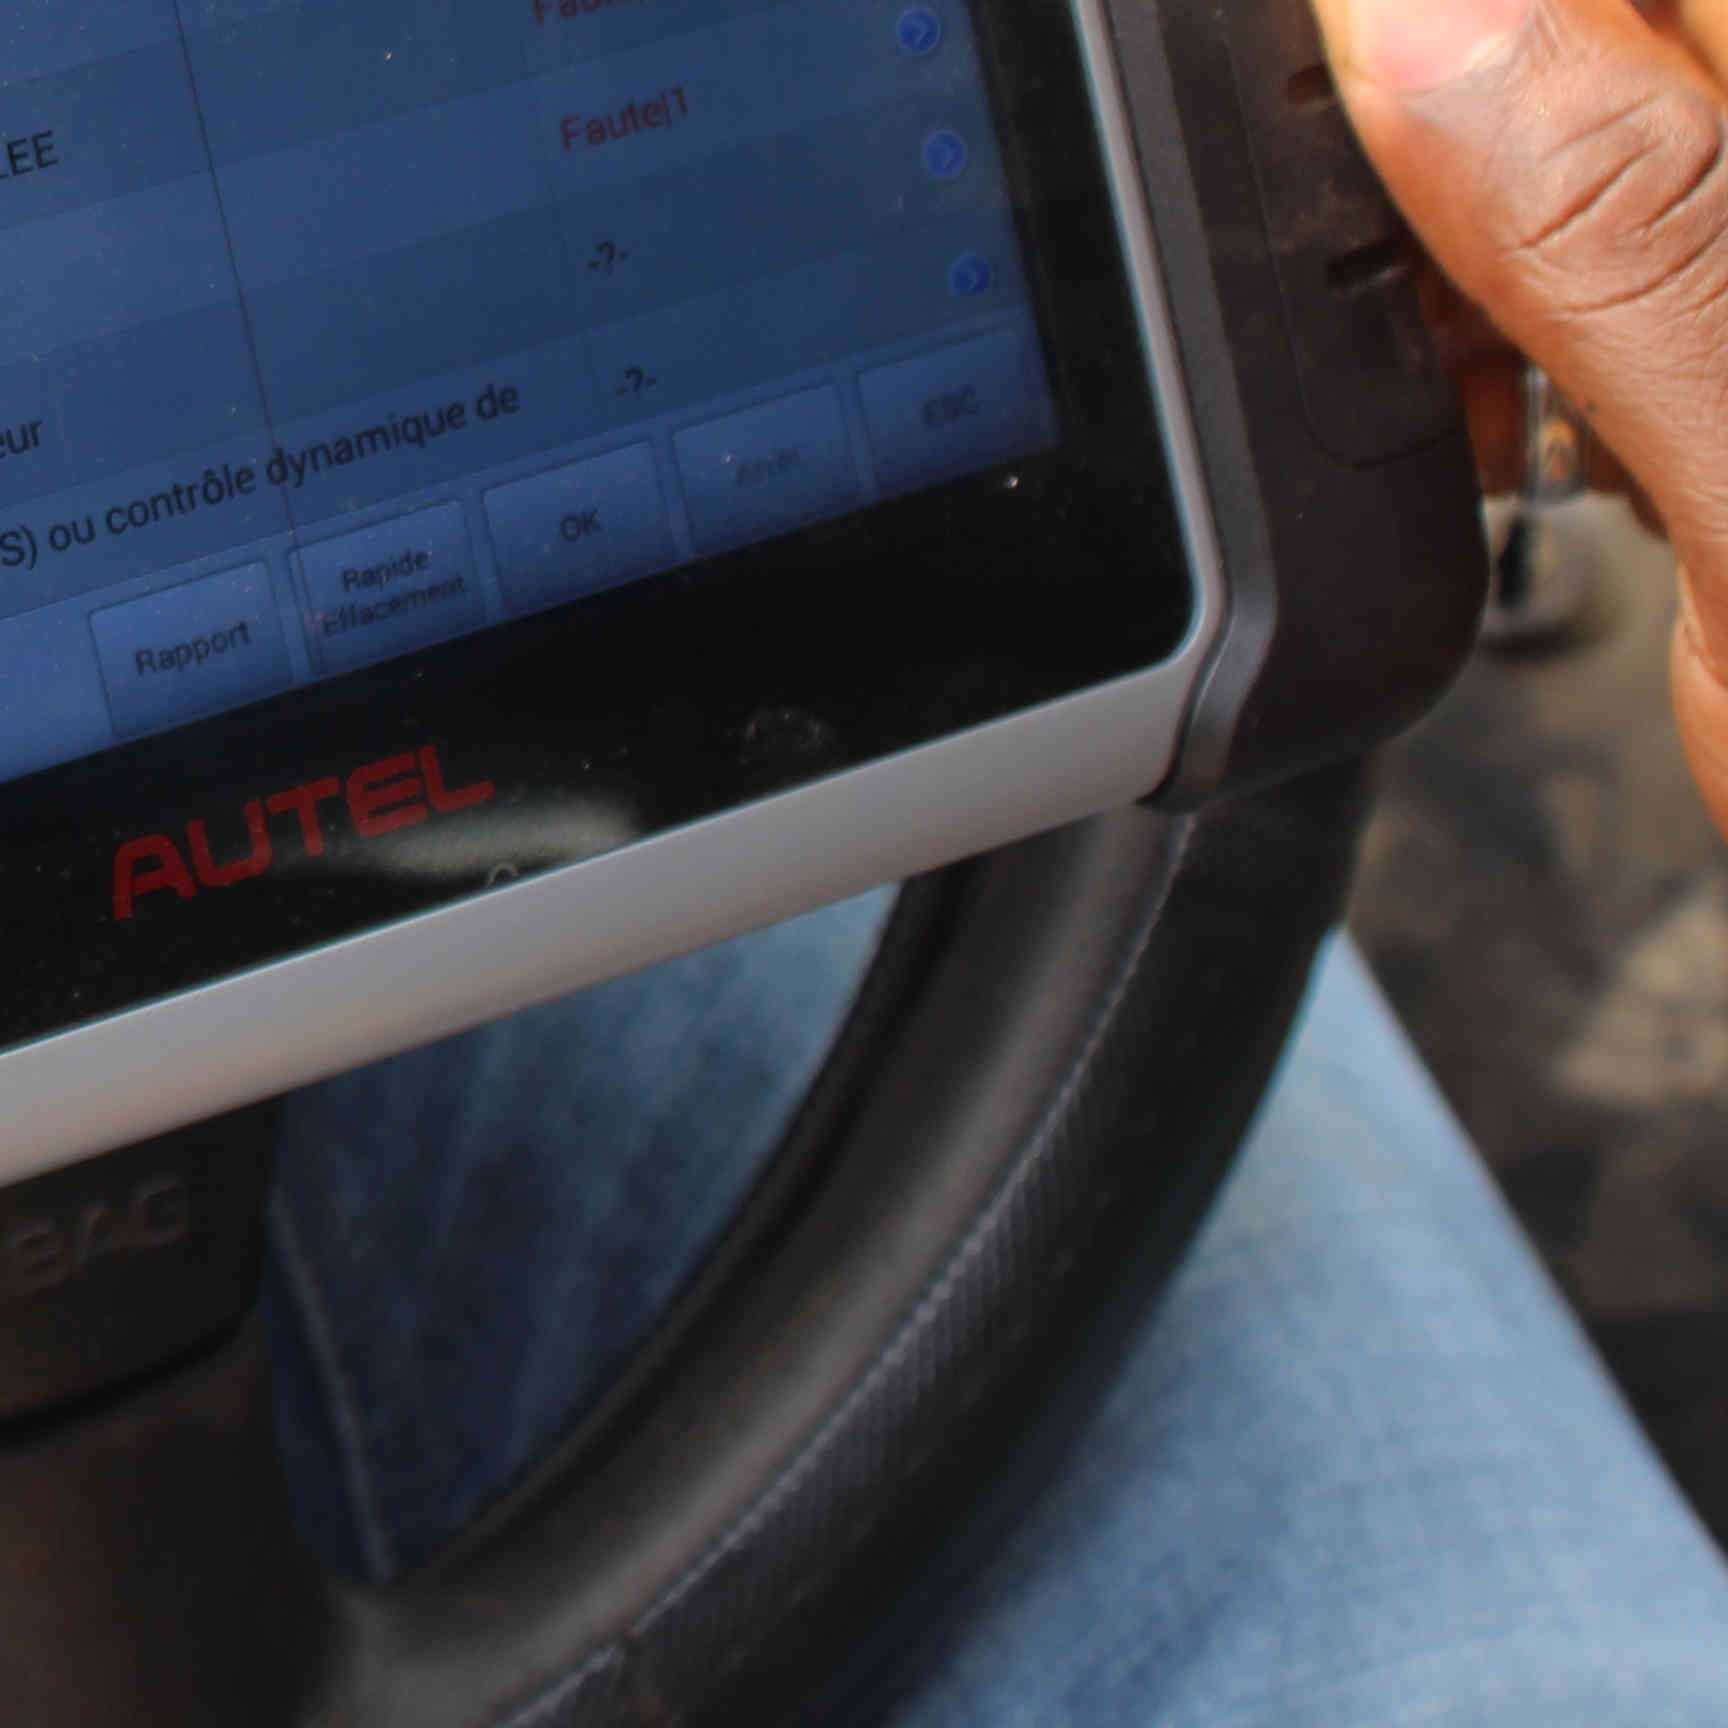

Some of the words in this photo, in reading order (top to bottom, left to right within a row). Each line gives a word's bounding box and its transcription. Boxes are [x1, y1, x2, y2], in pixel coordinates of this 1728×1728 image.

[49, 516, 97, 552] ou
[103, 459, 259, 536] contrôle
[267, 400, 466, 490] dynamique
[474, 383, 522, 421] de
[558, 505, 604, 545] OK
[340, 545, 431, 595] Rapide
[321, 574, 465, 641] Effacement
[134, 620, 253, 679] Rapport
[112, 744, 495, 921] AUTEL
